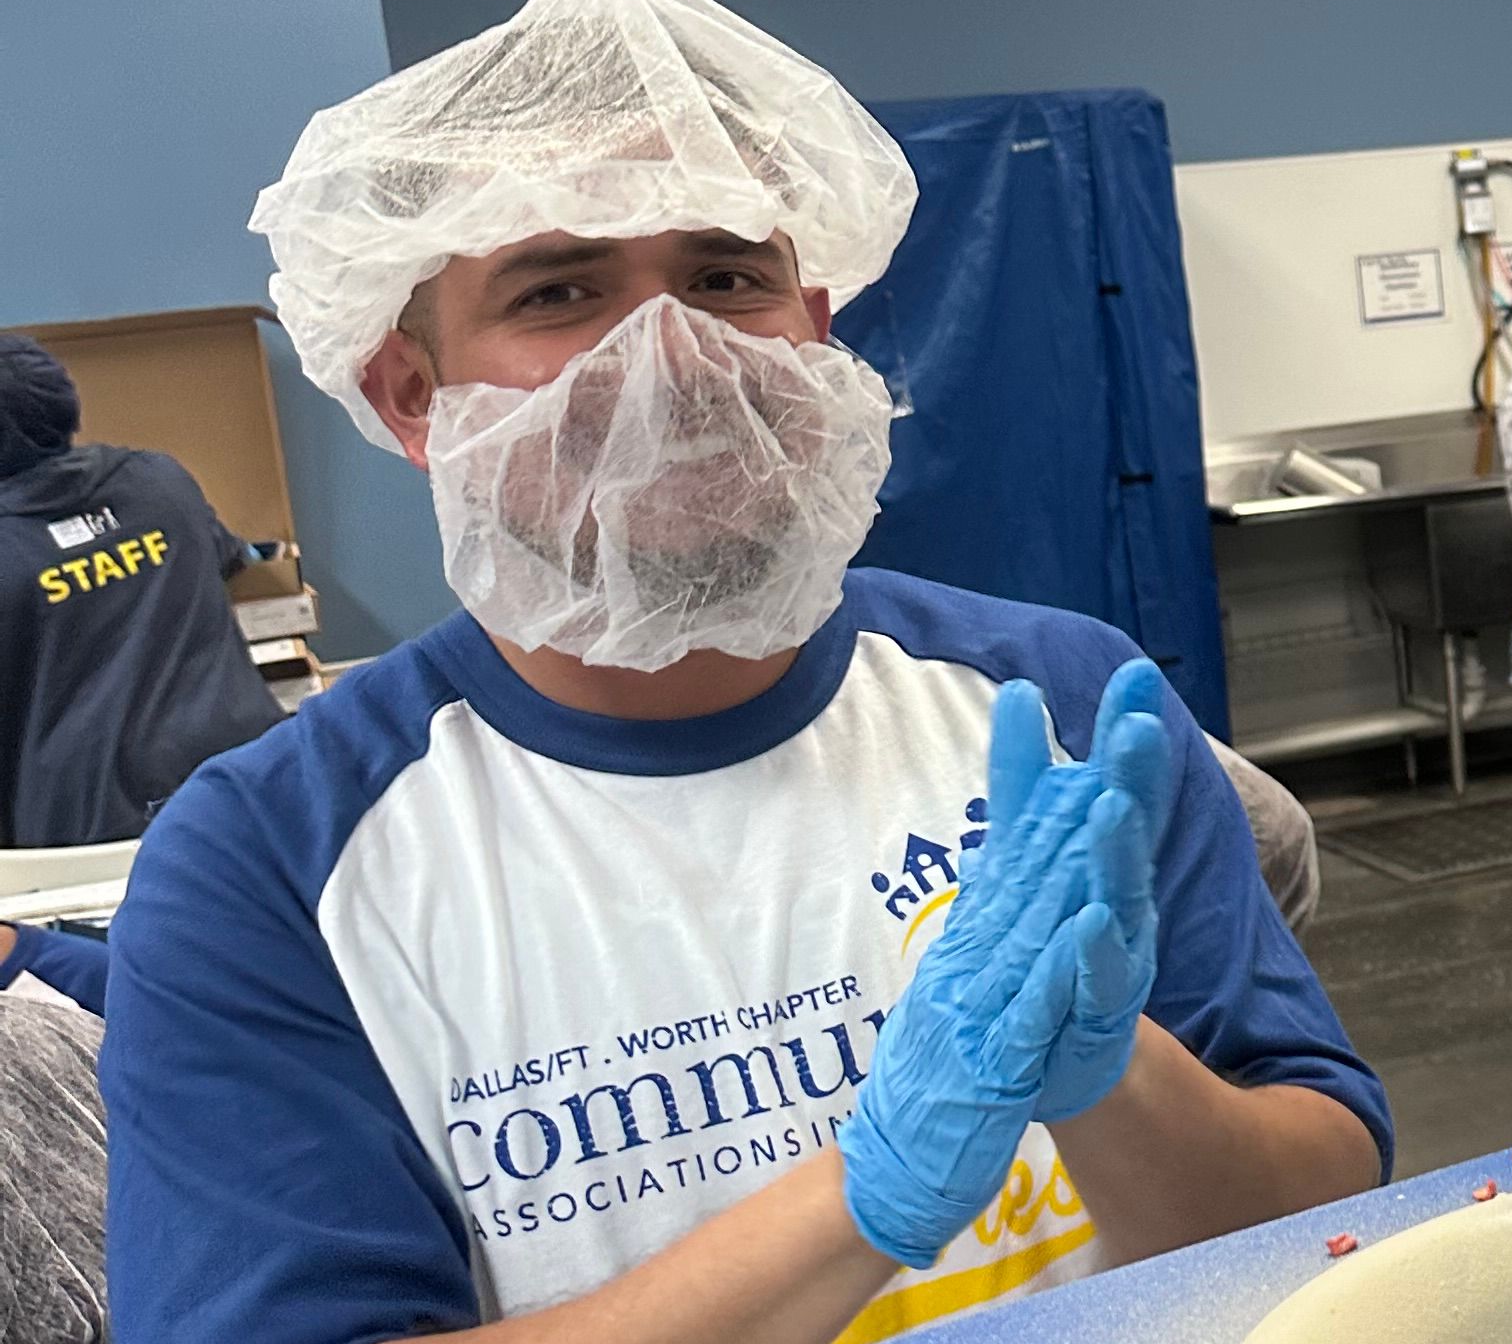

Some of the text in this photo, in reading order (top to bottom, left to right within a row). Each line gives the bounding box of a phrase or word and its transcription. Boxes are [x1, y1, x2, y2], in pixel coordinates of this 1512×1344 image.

[38, 529, 169, 605] STAFF
[616, 1009, 731, 1059] WORTH
[736, 974, 862, 1031] CHAPTER
[447, 1004, 897, 1192] commu
[470, 1127, 802, 1241] ASSOCIATIONS
